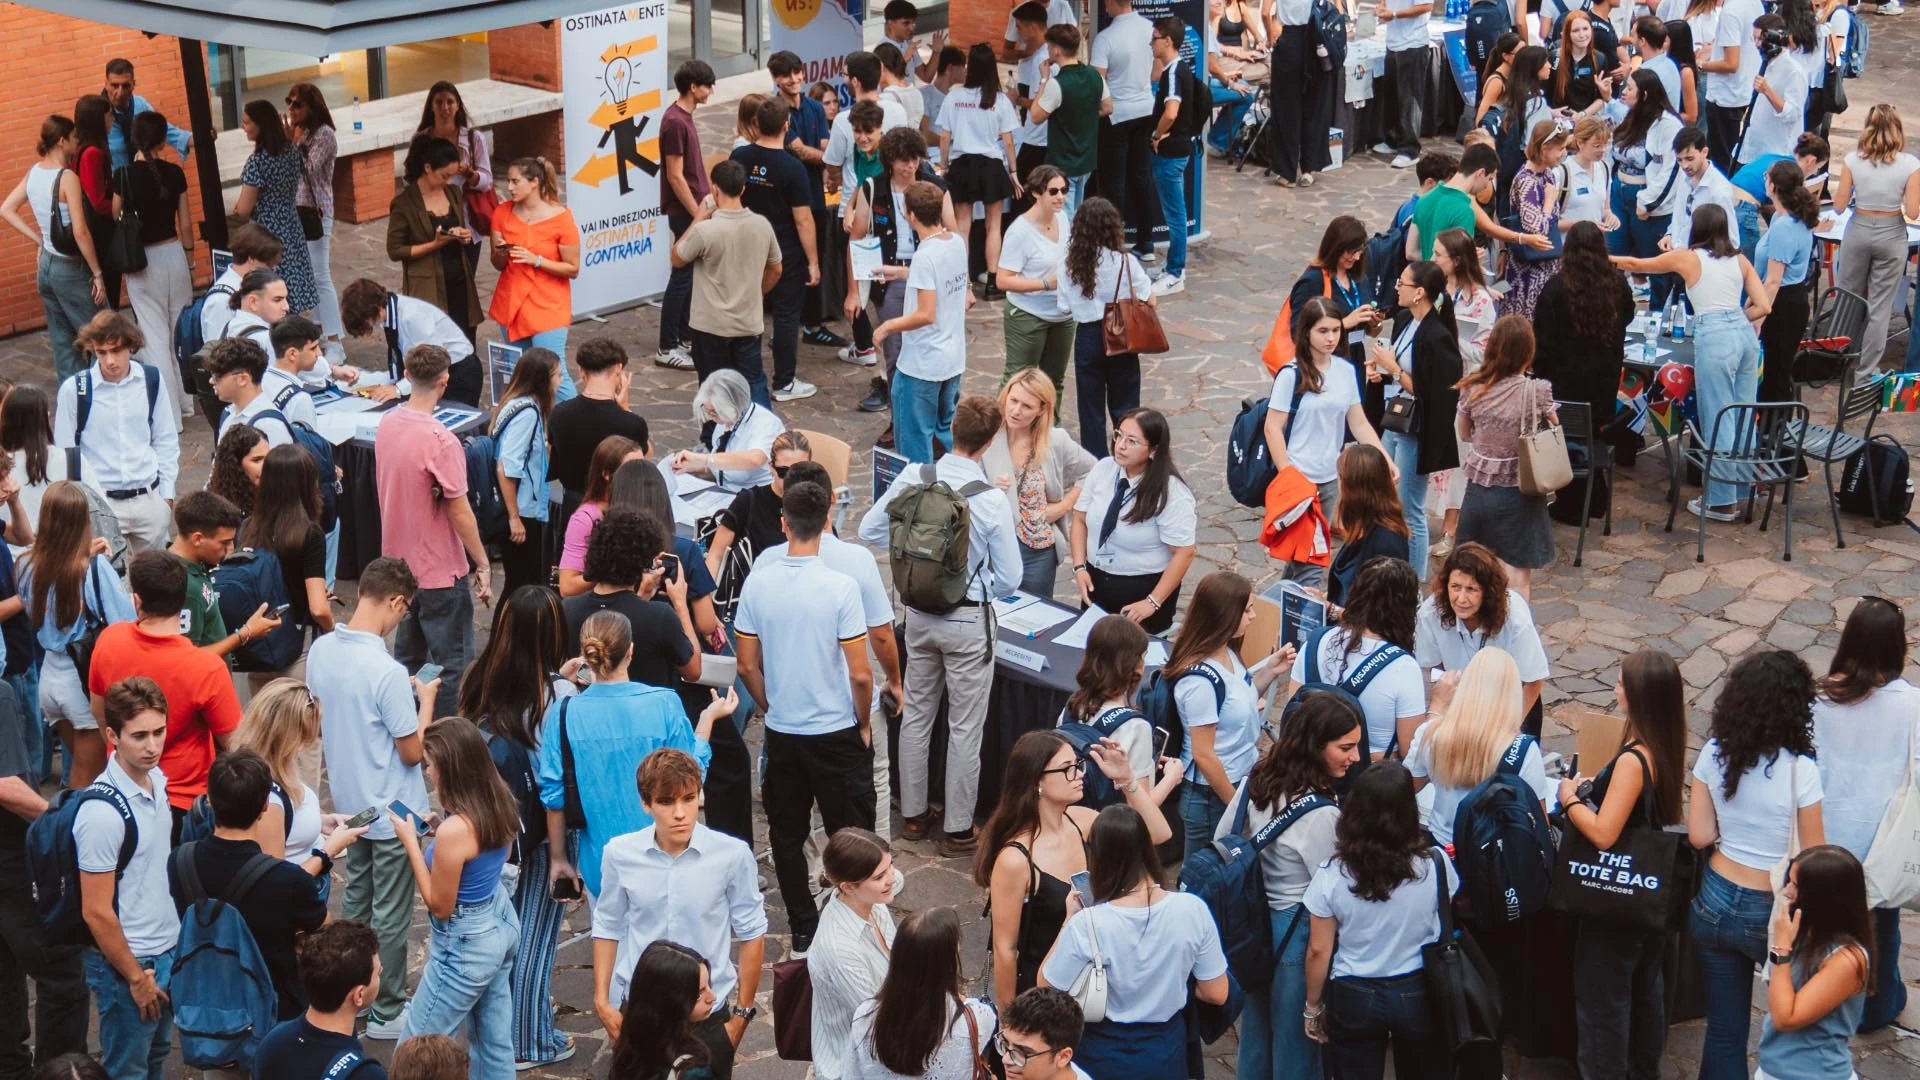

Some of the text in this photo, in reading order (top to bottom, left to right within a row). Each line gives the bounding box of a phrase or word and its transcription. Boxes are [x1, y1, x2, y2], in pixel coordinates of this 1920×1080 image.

[566, 3, 665, 31] OSTINATAMENTE
[802, 56, 845, 84] ADAM
[581, 206, 662, 235] VAI IN DIREZIONE
[585, 218, 656, 250] OSTINATA E
[585, 236, 652, 267] CONTRARIA
[1200, 665, 1220, 684] Luiss
[1350, 651, 1389, 688] University
[115, 793, 131, 820] Luiss
[1290, 794, 1318, 810] Luiss
[1598, 850, 1632, 868] THE
[1568, 860, 1662, 890] TOTE BAG
[1581, 879, 1634, 895] MARC JACOBS
[1505, 888, 1520, 921] LUISS
[328, 1052, 359, 1077] Luiss
